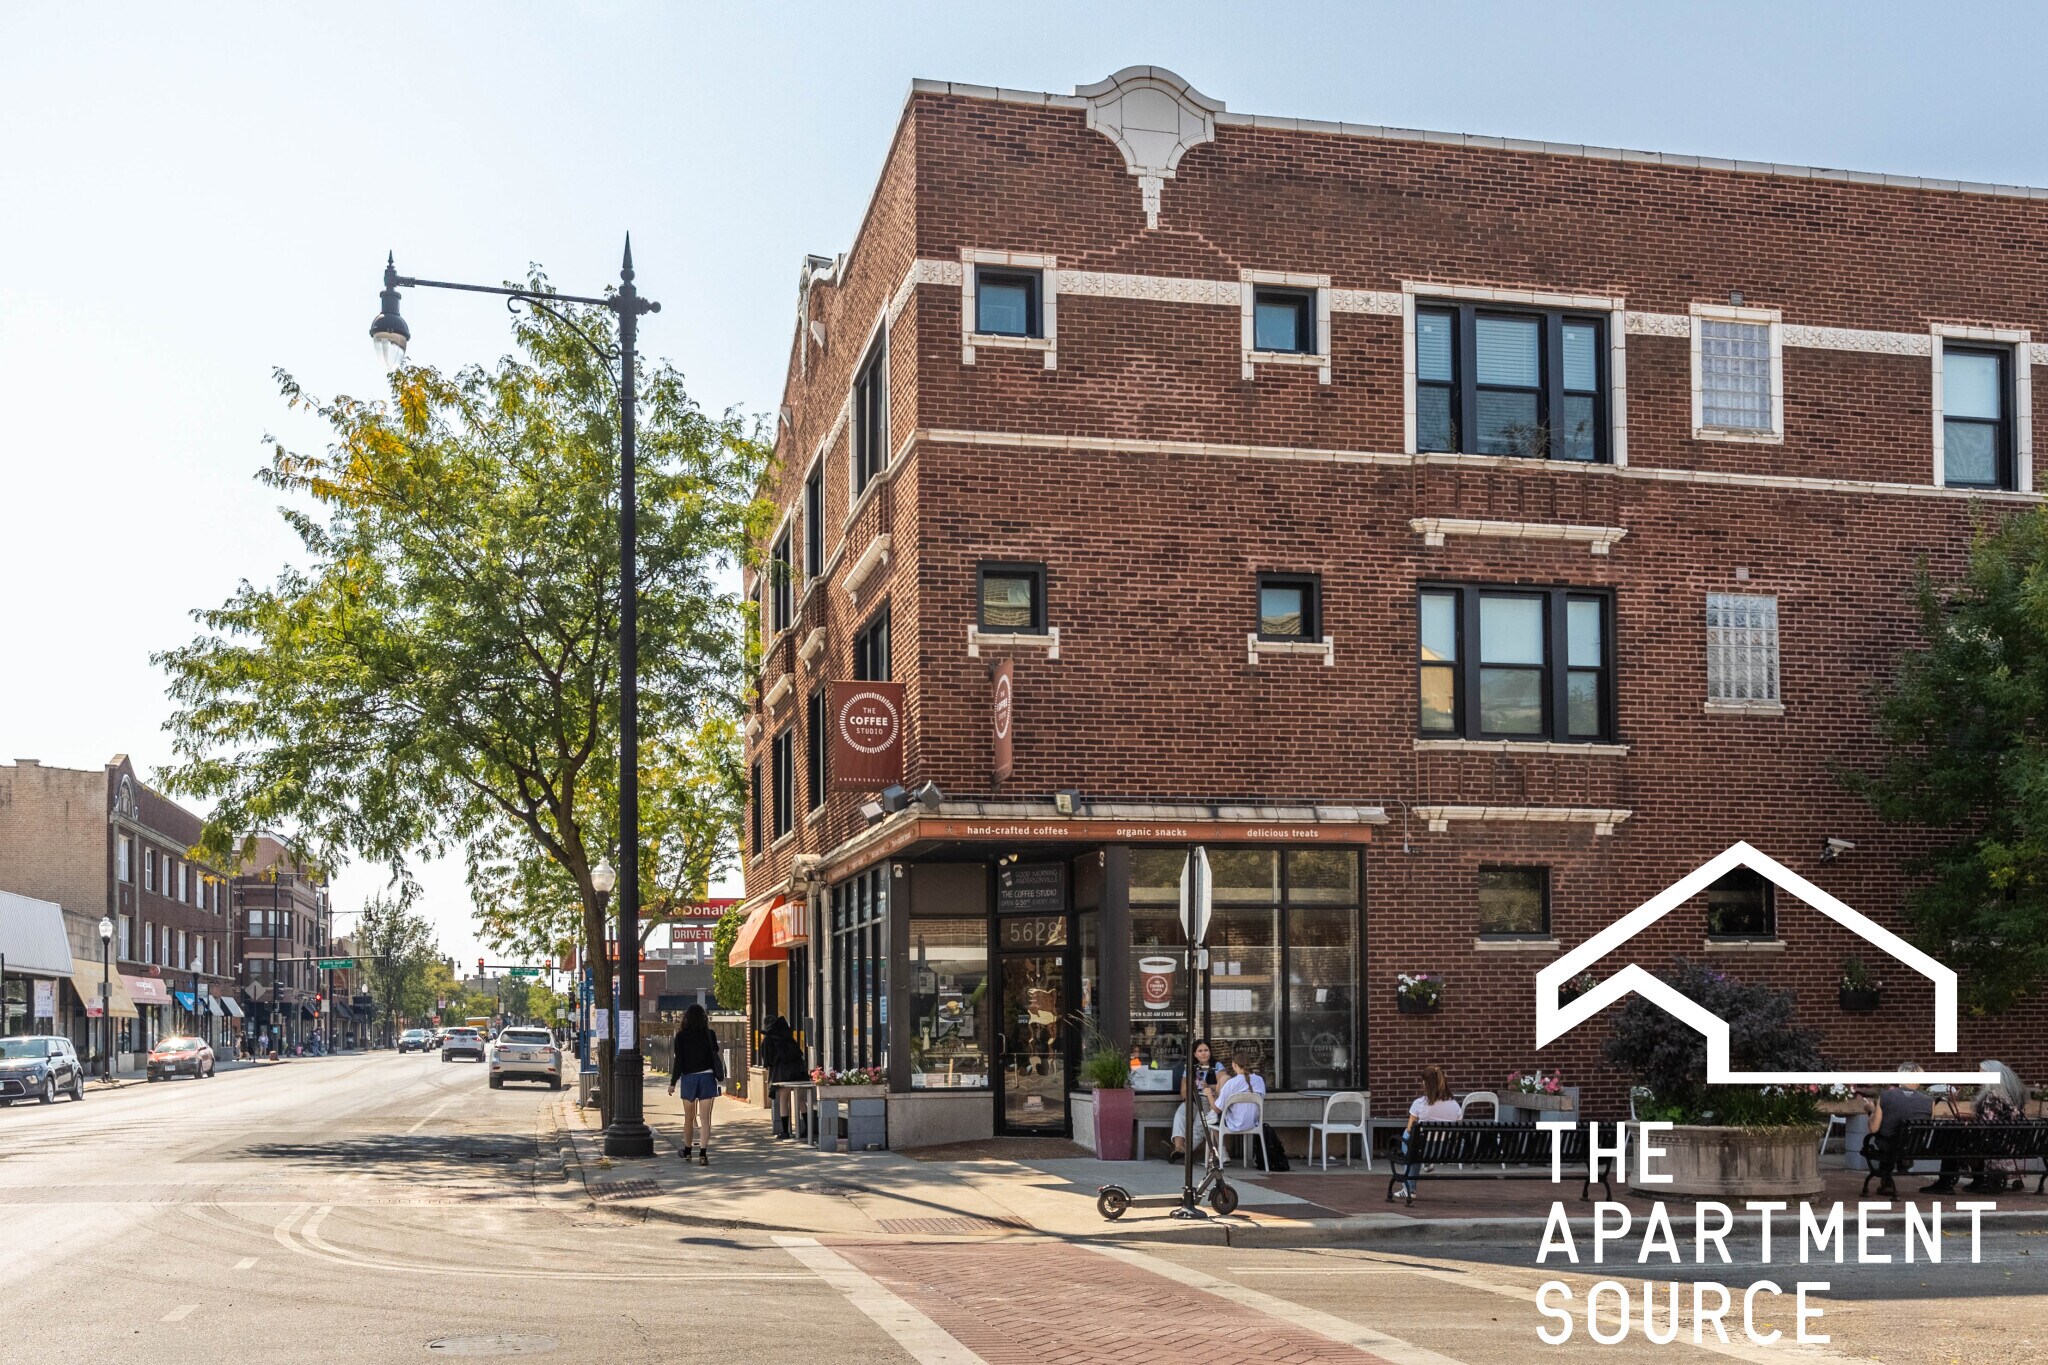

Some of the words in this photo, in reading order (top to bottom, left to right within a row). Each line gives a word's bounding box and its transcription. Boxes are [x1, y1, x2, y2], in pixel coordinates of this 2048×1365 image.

[849, 716, 888, 726] COFFEE
[856, 727, 883, 735] STUDIO
[967, 826, 1030, 835] hand-crafted
[1033, 826, 1069, 835] coffees
[1116, 827, 1151, 837] organic
[1155, 827, 1187, 837] snacks
[1247, 828, 1289, 837] delicious
[1292, 829, 1318, 838] treats
[1001, 890, 1014, 898] THE
[1014, 889, 1035, 898] COFFEE
[1035, 889, 1057, 897] STUDIO
[1010, 922, 1062, 942] 5628
